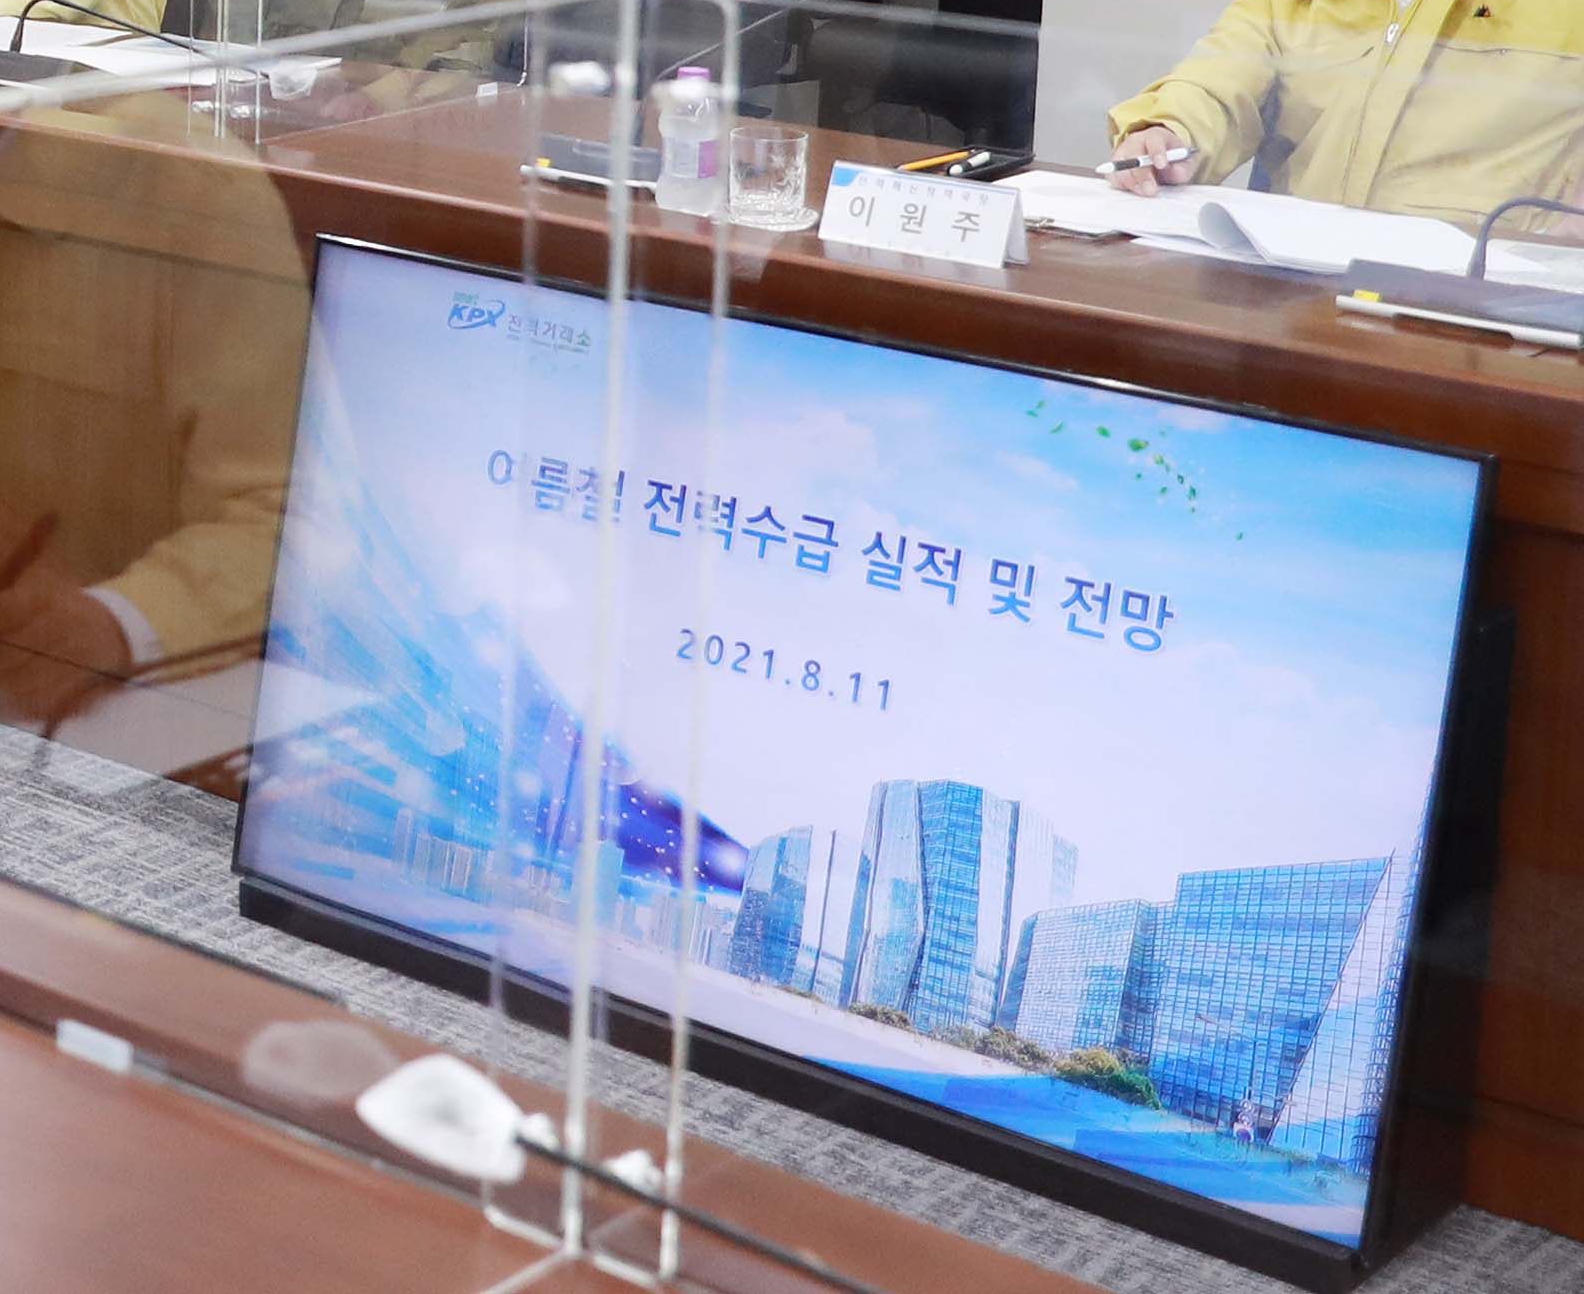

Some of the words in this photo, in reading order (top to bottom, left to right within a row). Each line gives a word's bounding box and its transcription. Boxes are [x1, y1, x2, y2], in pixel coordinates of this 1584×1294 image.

[448, 301, 503, 328] KPX
[642, 477, 840, 575] 전력수급
[861, 529, 967, 606] 실적
[987, 556, 1037, 624] 및
[1058, 574, 1176, 654] 전망
[676, 628, 893, 711] 2021.8.11
